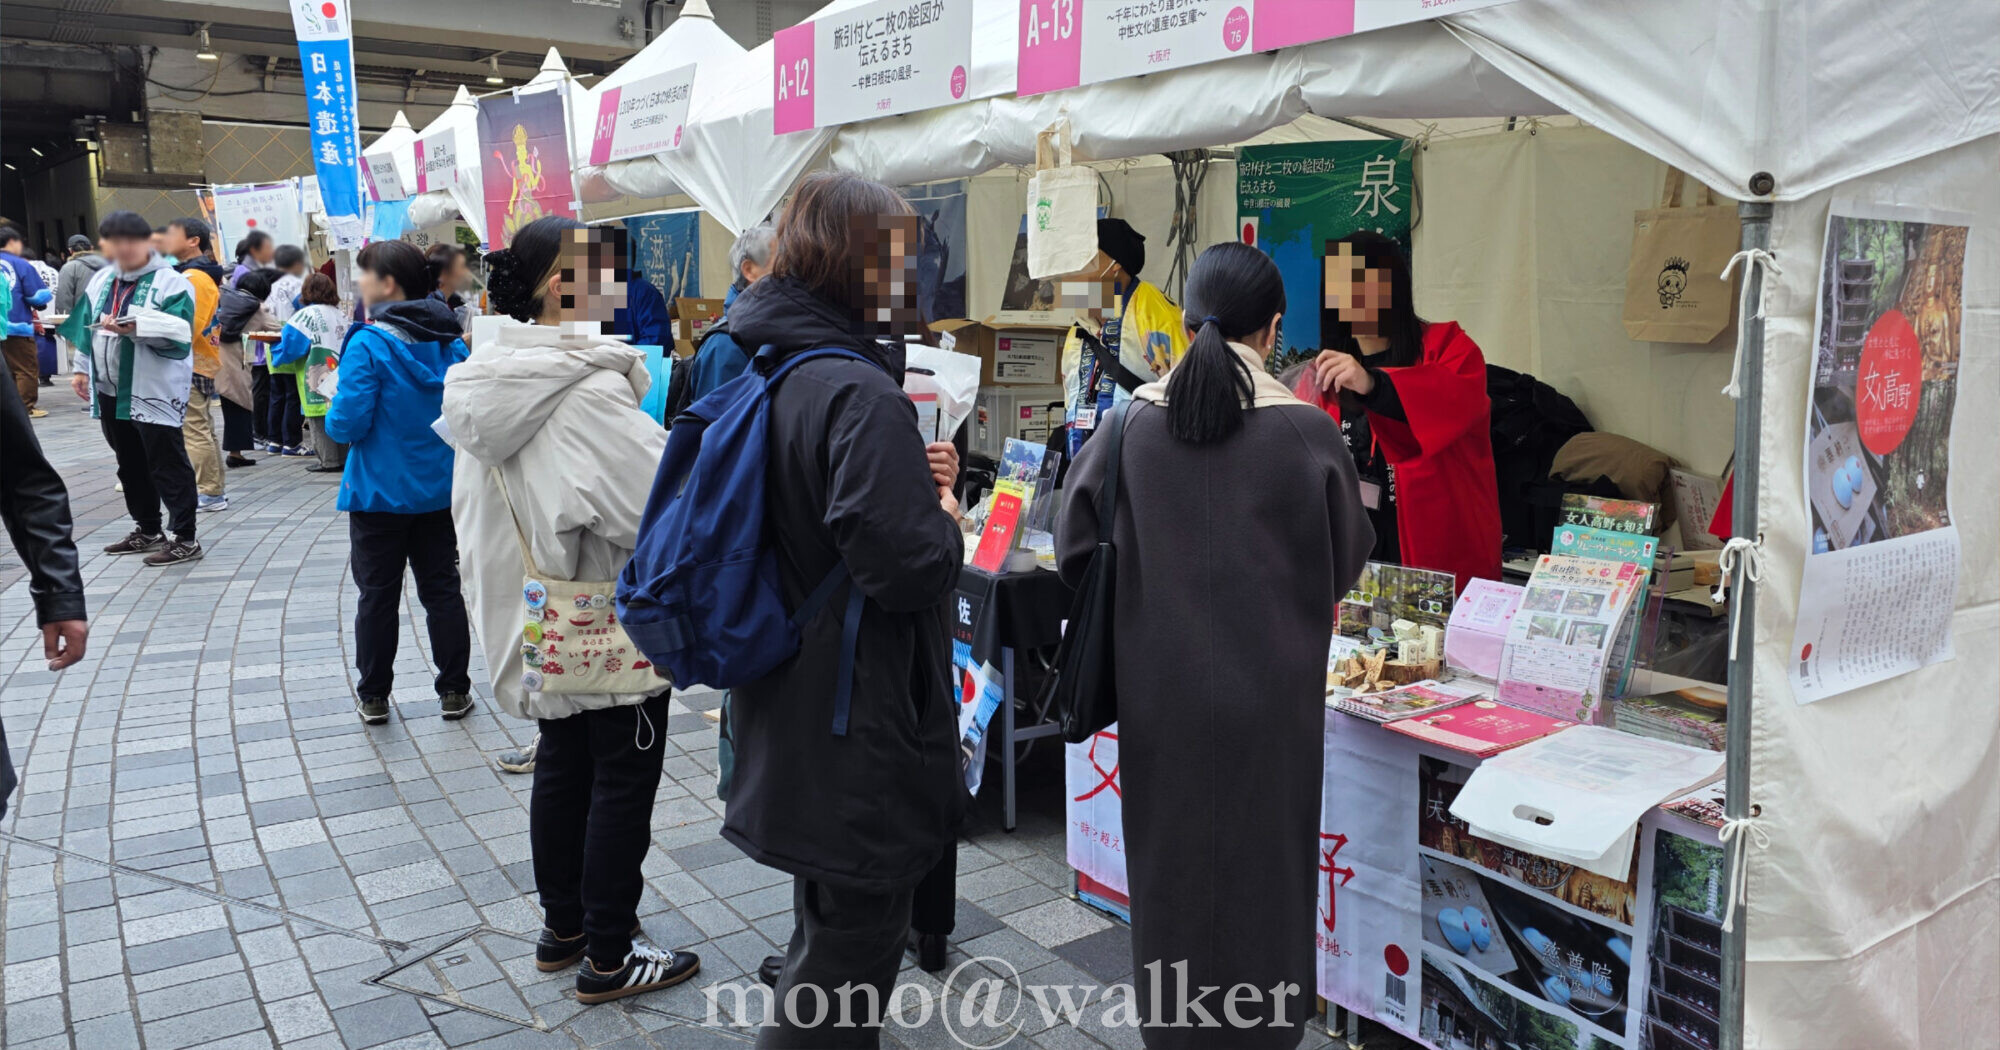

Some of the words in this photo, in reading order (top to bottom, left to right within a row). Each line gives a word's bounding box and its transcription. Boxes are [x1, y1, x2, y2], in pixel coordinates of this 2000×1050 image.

[834, 0, 944, 50] 旅引付と二枚の絵図が
[1026, 0, 1072, 47] A-13
[1230, 30, 1241, 44] 76
[858, 34, 912, 67] 伝えるまち
[1147, 49, 1171, 64] 大阪府
[778, 58, 809, 101] A-12
[310, 52, 342, 166] 日本遺産
[876, 98, 892, 111] 大阪府
[596, 112, 615, 141] A-11
[1565, 511, 1645, 534] 女人高野を知る
[1576, 538, 1640, 560] リレーウォーキング
[957, 596, 971, 625] 佐
[568, 648, 626, 659] いずみさの
[1541, 936, 1613, 987] 慈尊院
